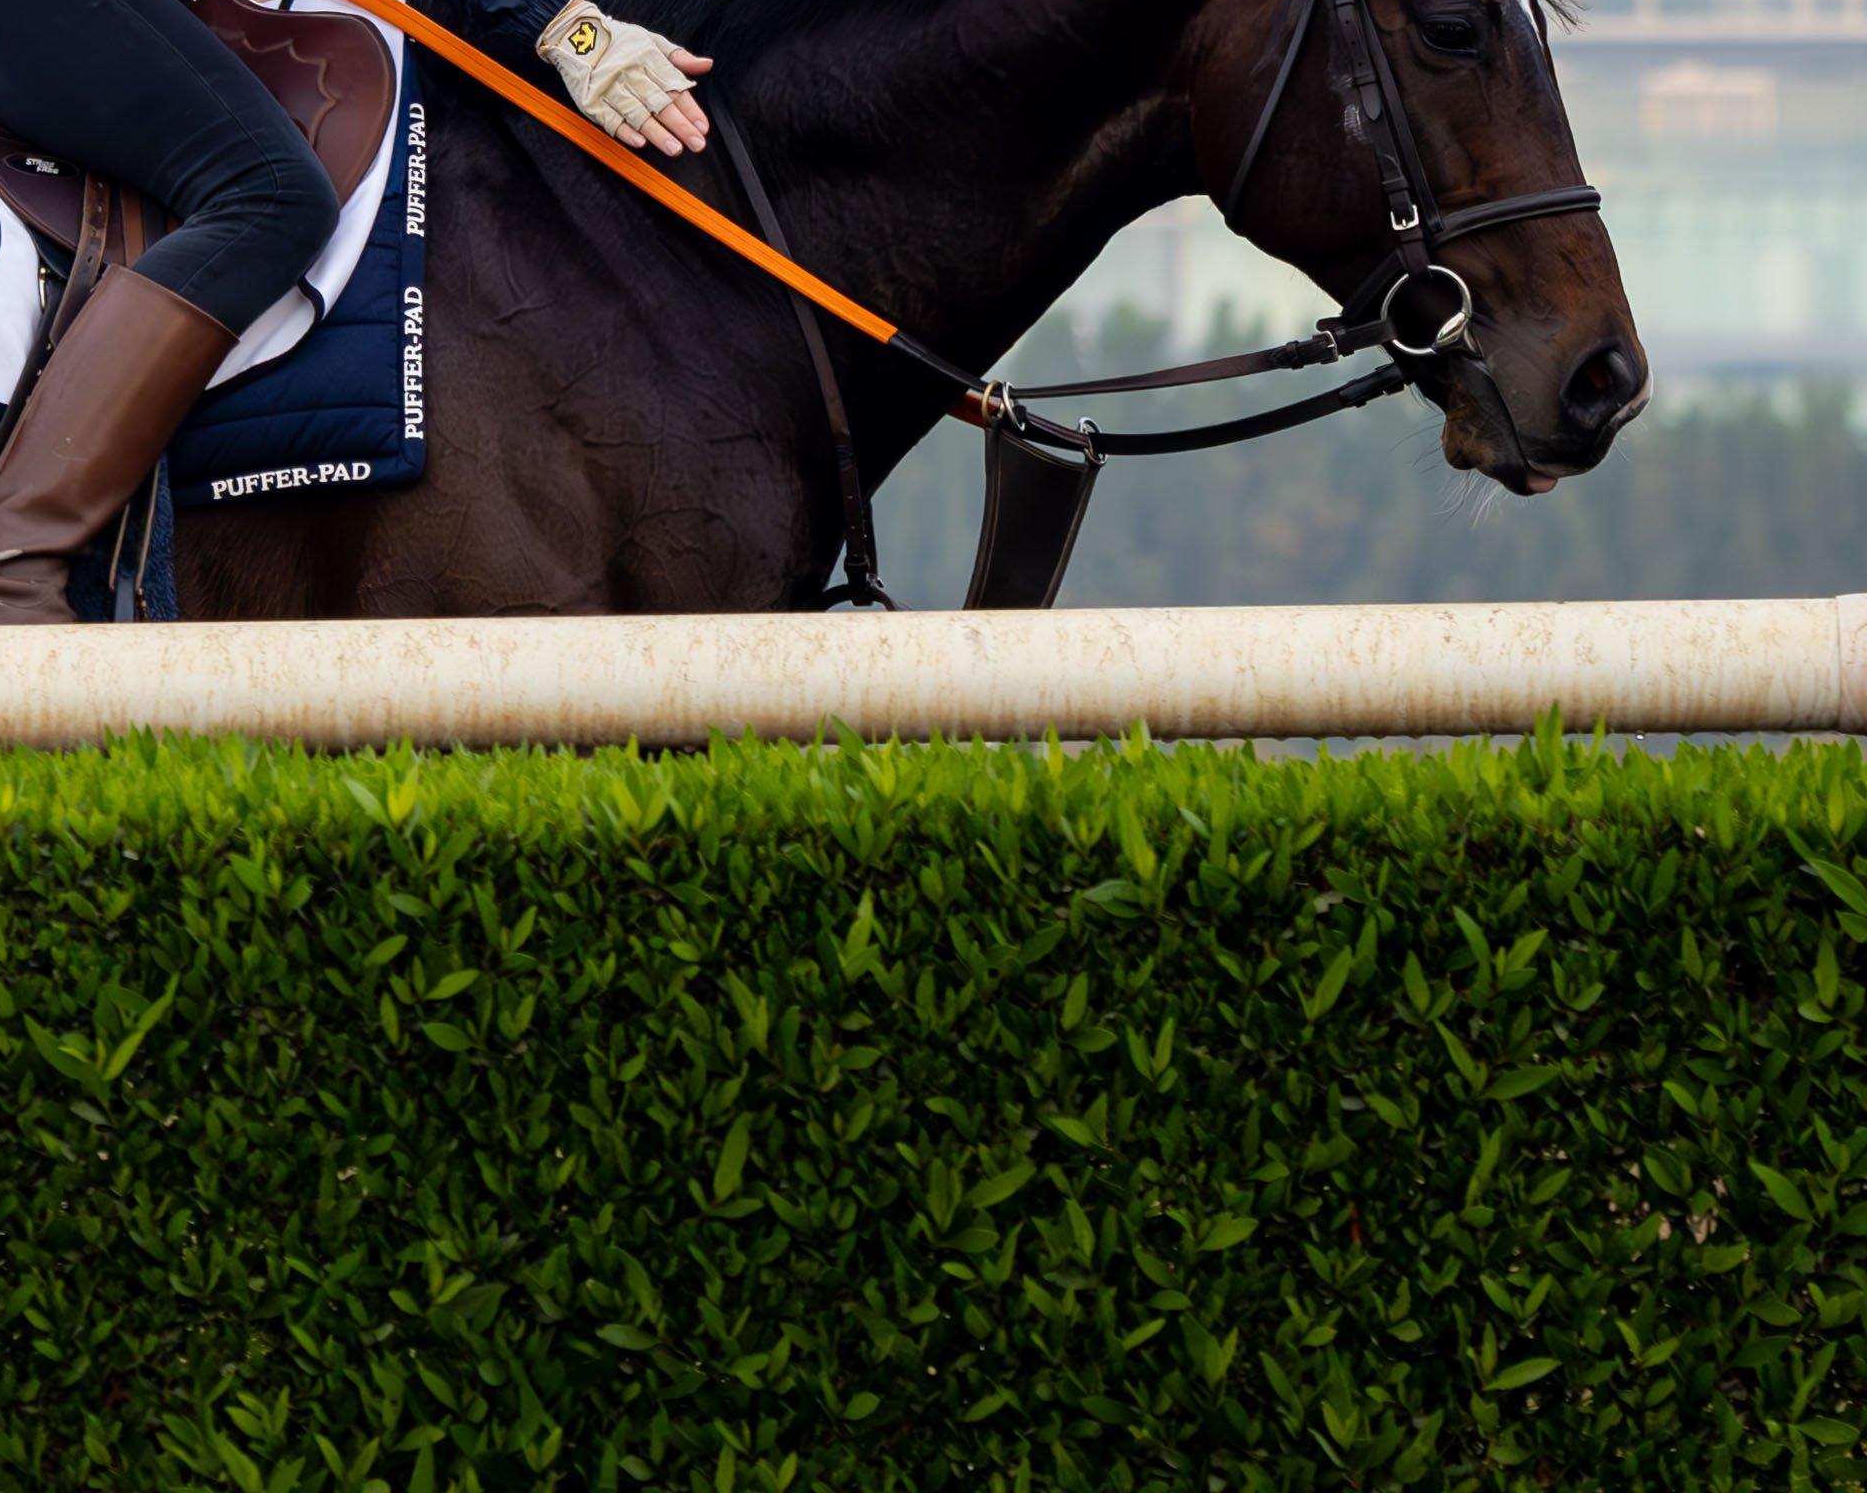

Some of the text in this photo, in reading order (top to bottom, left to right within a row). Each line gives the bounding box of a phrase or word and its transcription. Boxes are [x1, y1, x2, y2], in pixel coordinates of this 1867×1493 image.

[406, 101, 427, 238] PUFFER-PAD
[403, 284, 424, 441] PUFFER-PAD
[210, 460, 372, 501] PUFFER-PAD
